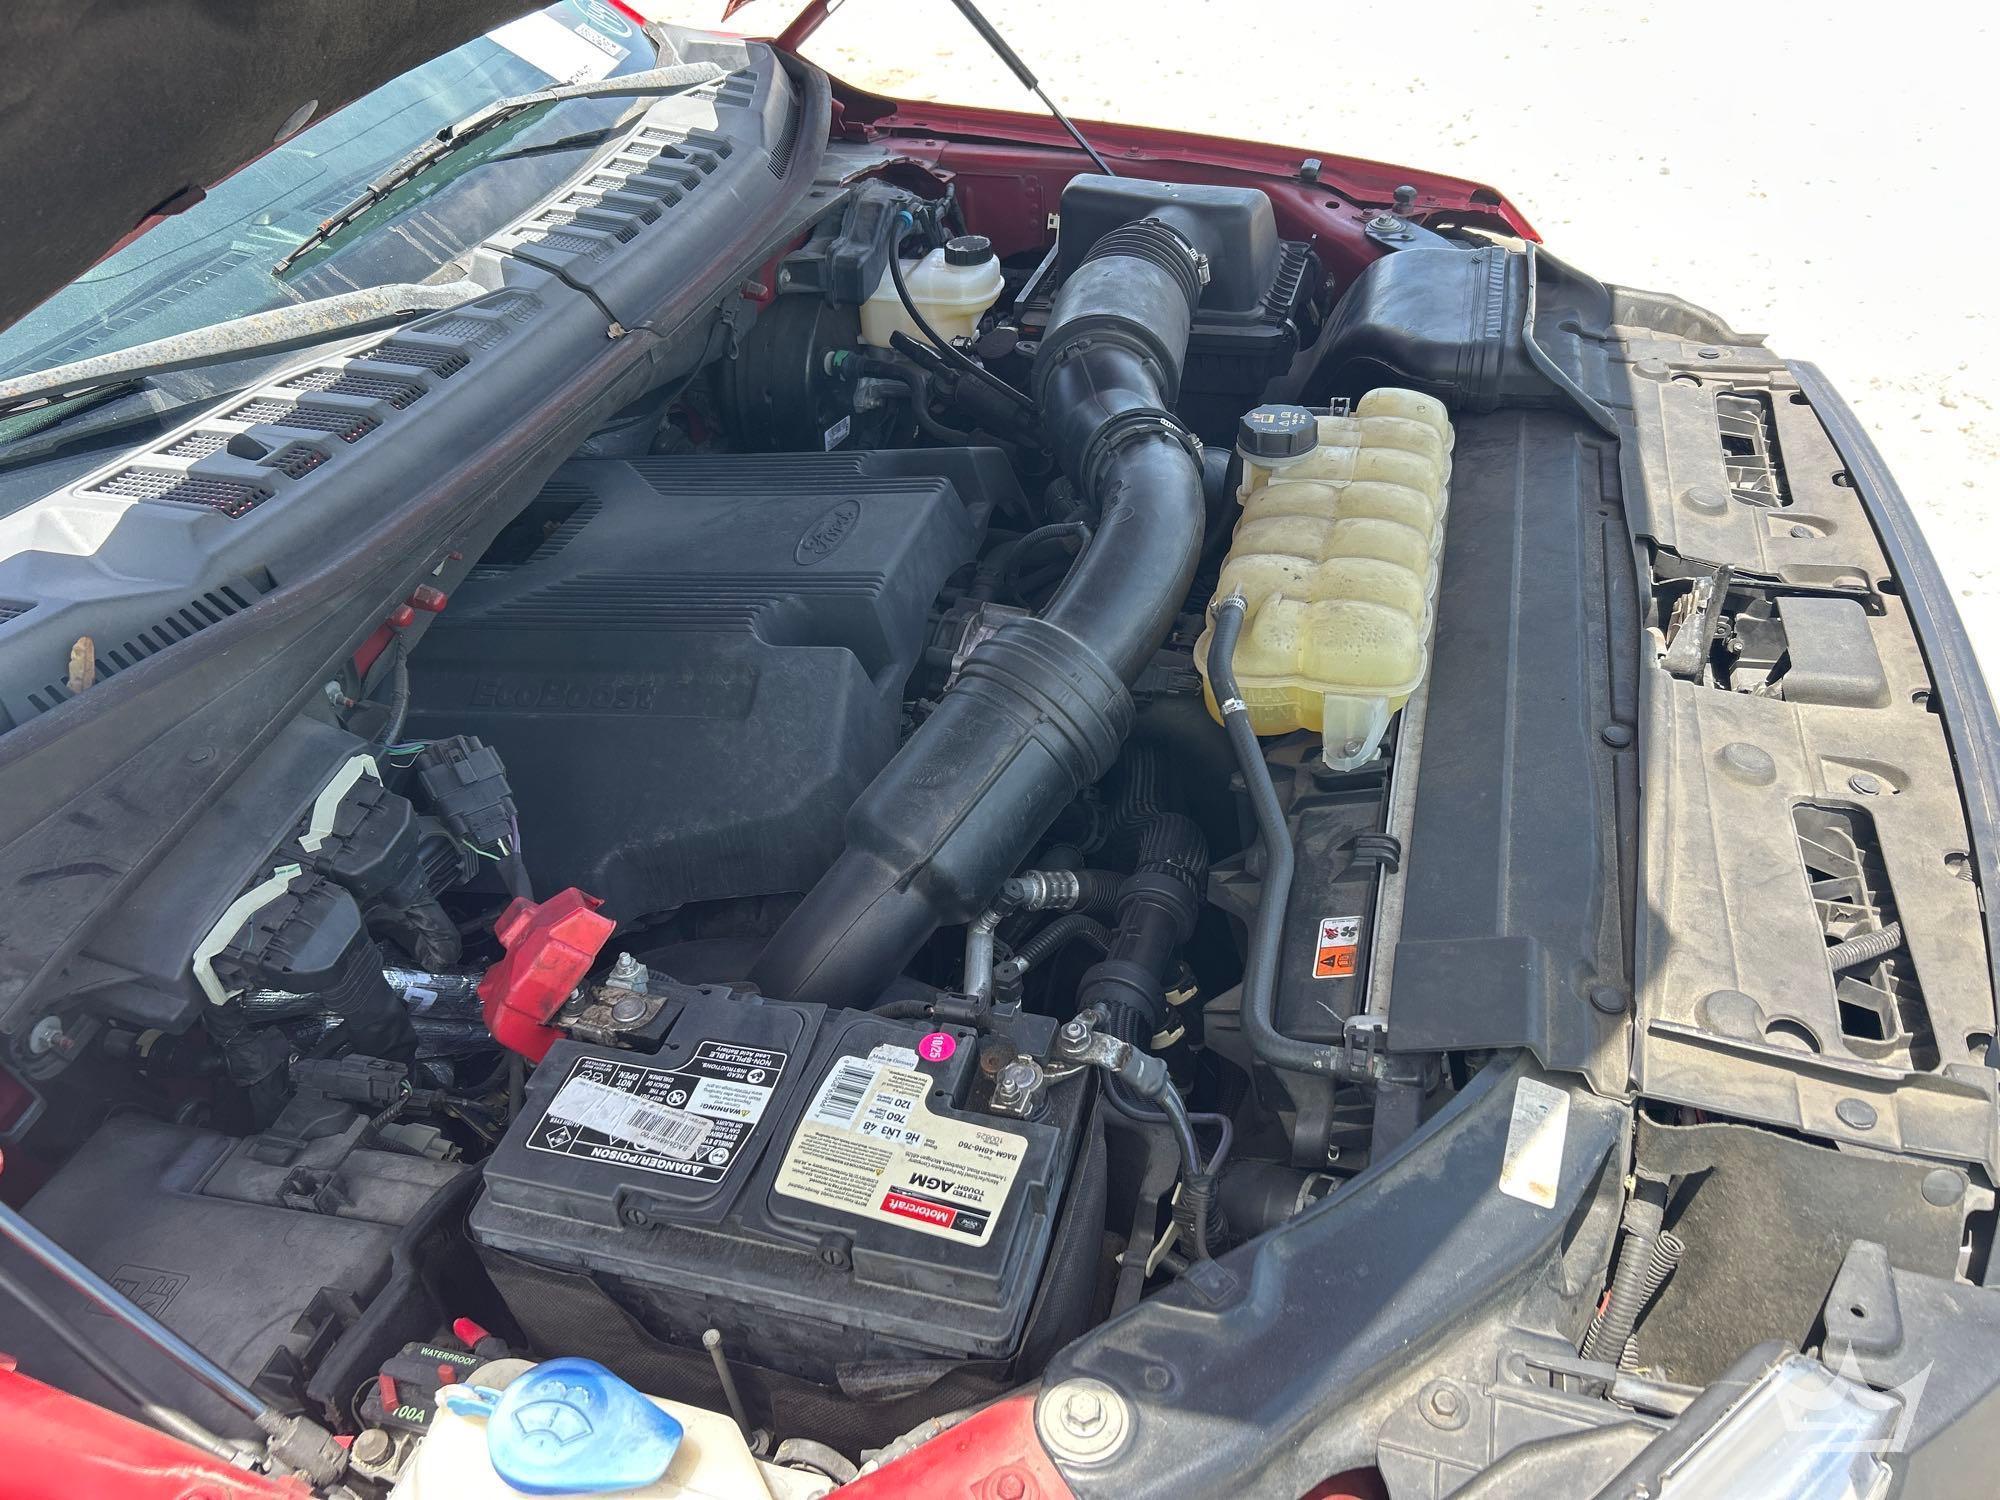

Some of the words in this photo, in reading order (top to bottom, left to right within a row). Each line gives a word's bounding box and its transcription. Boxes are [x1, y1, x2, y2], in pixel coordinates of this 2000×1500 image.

[468, 675, 657, 712] EcoBoost
[714, 1045, 740, 1054] Battery
[929, 1035, 944, 1059] 10/25
[707, 1050, 773, 1066] NON-SPILLABLE
[892, 1058, 915, 1068] Germany
[698, 1061, 749, 1073] INSTRUCTIONS.
[614, 1069, 641, 1081] OPEN.
[645, 1072, 675, 1082] CHILDREN.
[725, 1071, 745, 1079] READ
[614, 1078, 634, 1087] NOT
[652, 1081, 671, 1089] REACH
[697, 1102, 742, 1114] WARNING!
[893, 1098, 912, 1109] 120
[885, 1111, 906, 1123] 760
[862, 1121, 878, 1131] 48
[880, 1125, 901, 1137] LN3
[706, 1129, 738, 1141] EXPLOSIV
[903, 1131, 921, 1142] H6
[711, 1138, 735, 1148] SHIELD
[956, 1140, 1018, 1160] BAGM-48H6-760
[588, 1145, 694, 1174] DANGER/POISON
[919, 1153, 942, 1164] Michigan
[944, 1166, 957, 1174] Ford
[979, 1169, 1004, 1179] American
[907, 1171, 955, 1194] AGM
[963, 1171, 1000, 1185] Manufactured
[951, 1188, 983, 1201] TESTED
[886, 1197, 949, 1222] Motorcraft
[420, 1346, 477, 1366] WATERPROOF
